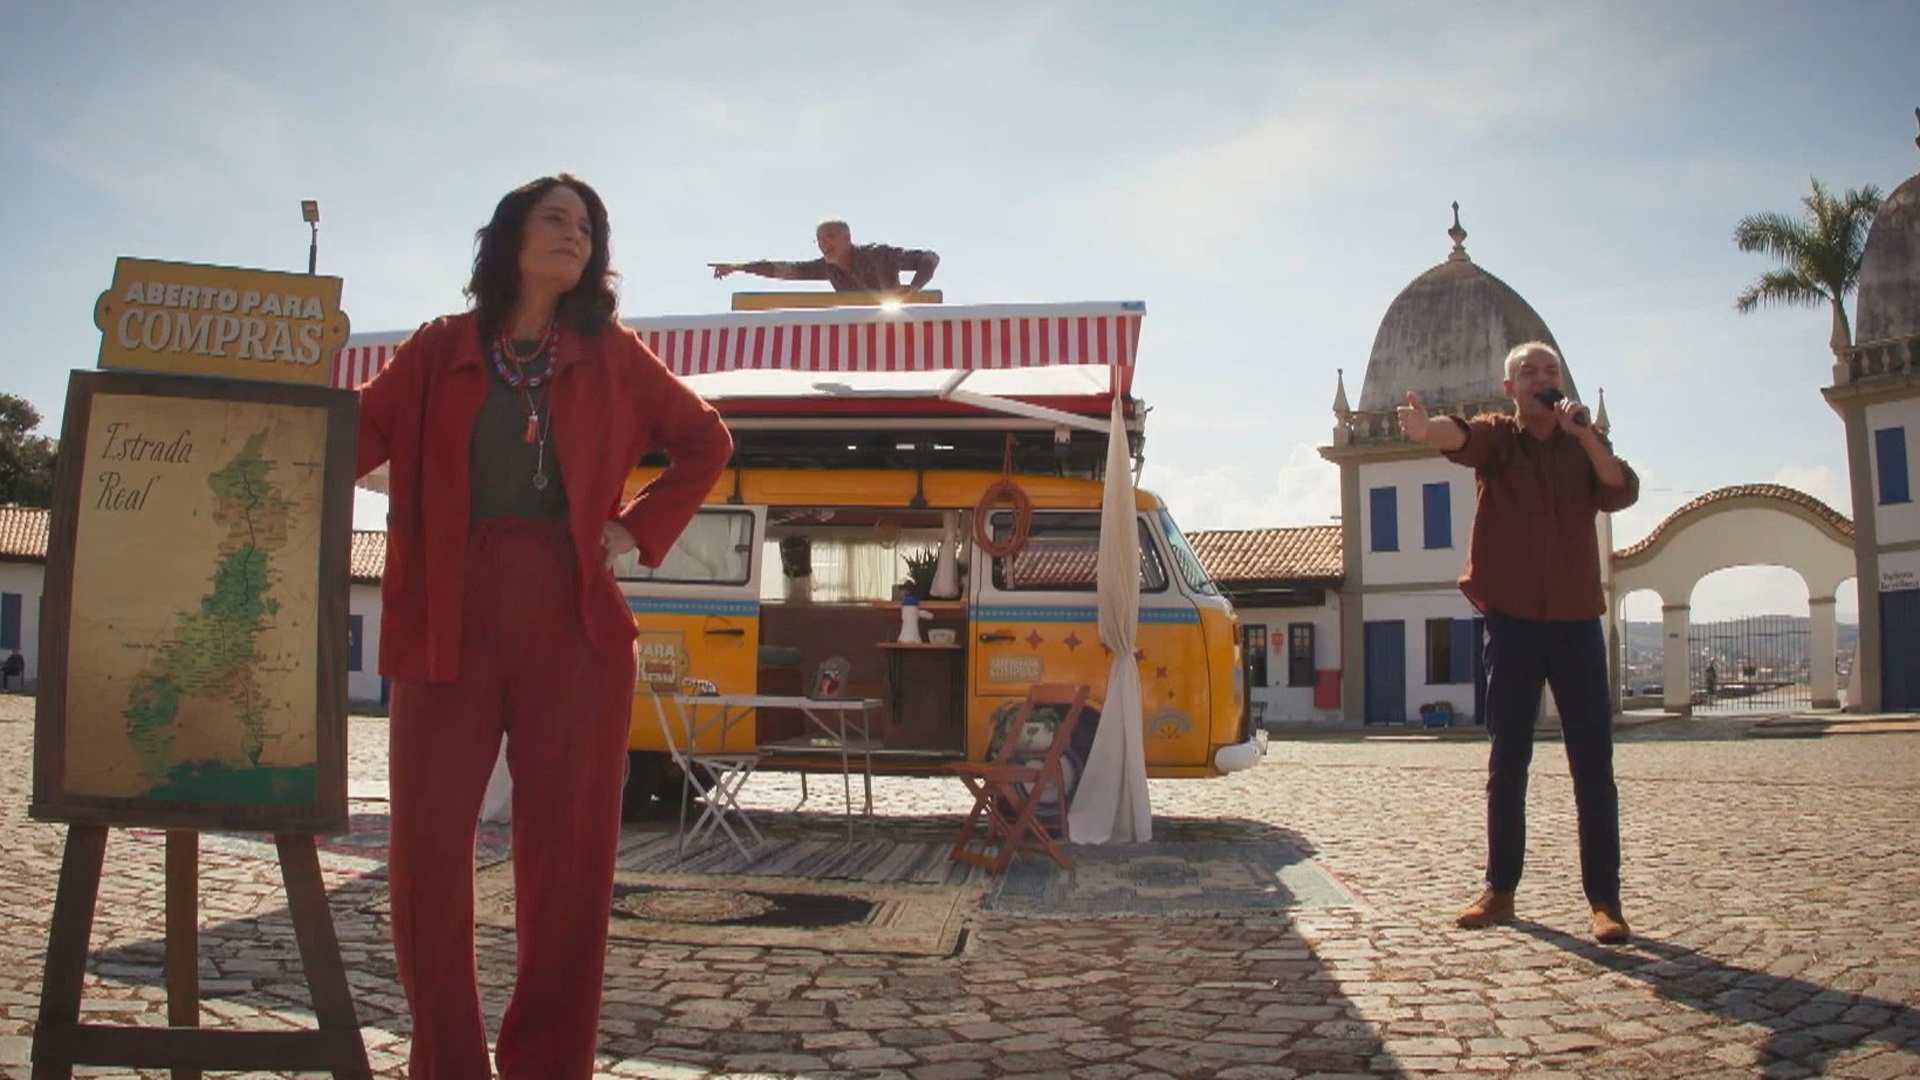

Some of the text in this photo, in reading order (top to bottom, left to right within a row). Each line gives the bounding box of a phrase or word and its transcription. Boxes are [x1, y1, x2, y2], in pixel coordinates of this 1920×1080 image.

[126, 281, 325, 321] ABERTO PARA
[118, 307, 324, 366] COMPRAS
[102, 422, 192, 463] Estrada
[96, 471, 160, 510] Real
